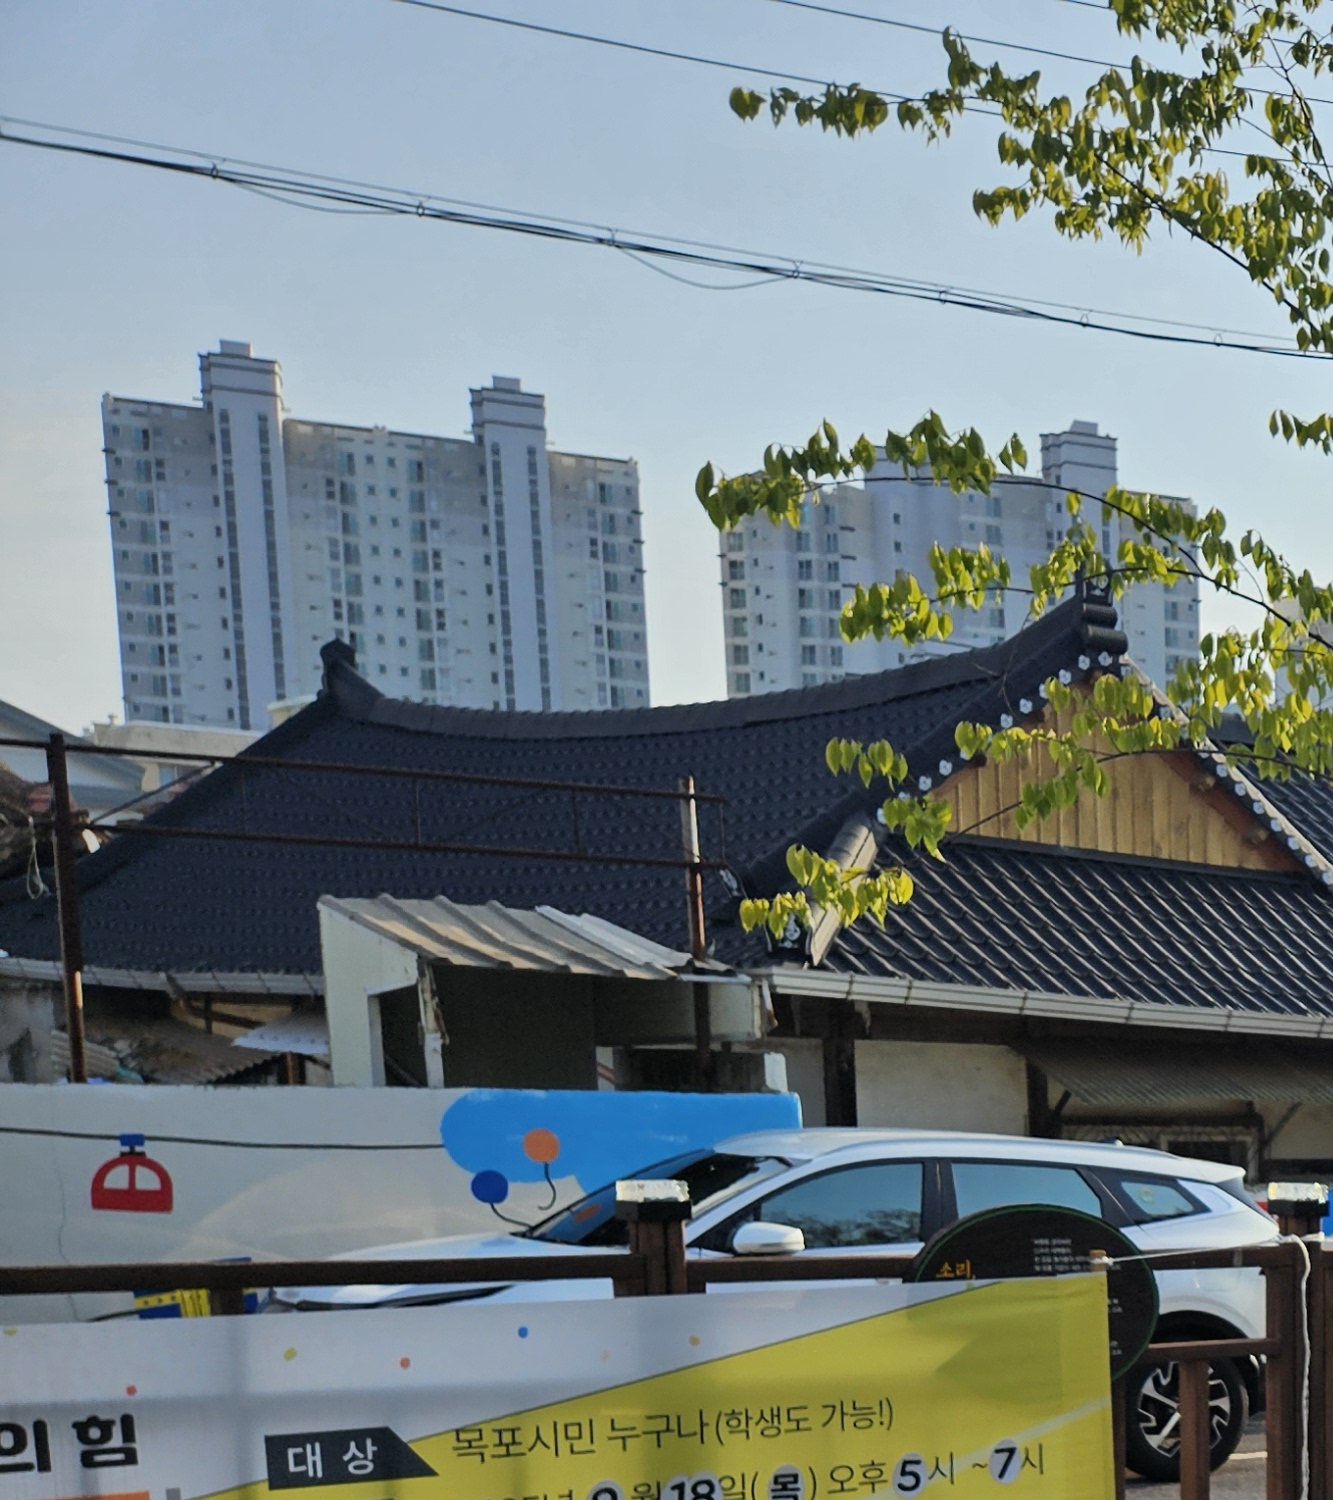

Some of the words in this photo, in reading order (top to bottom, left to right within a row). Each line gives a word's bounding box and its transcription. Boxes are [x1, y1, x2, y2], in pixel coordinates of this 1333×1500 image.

[72, 1413, 139, 1469] 힘
[451, 1417, 596, 1463] 목포시민
[821, 1397, 894, 1432] 가능!)
